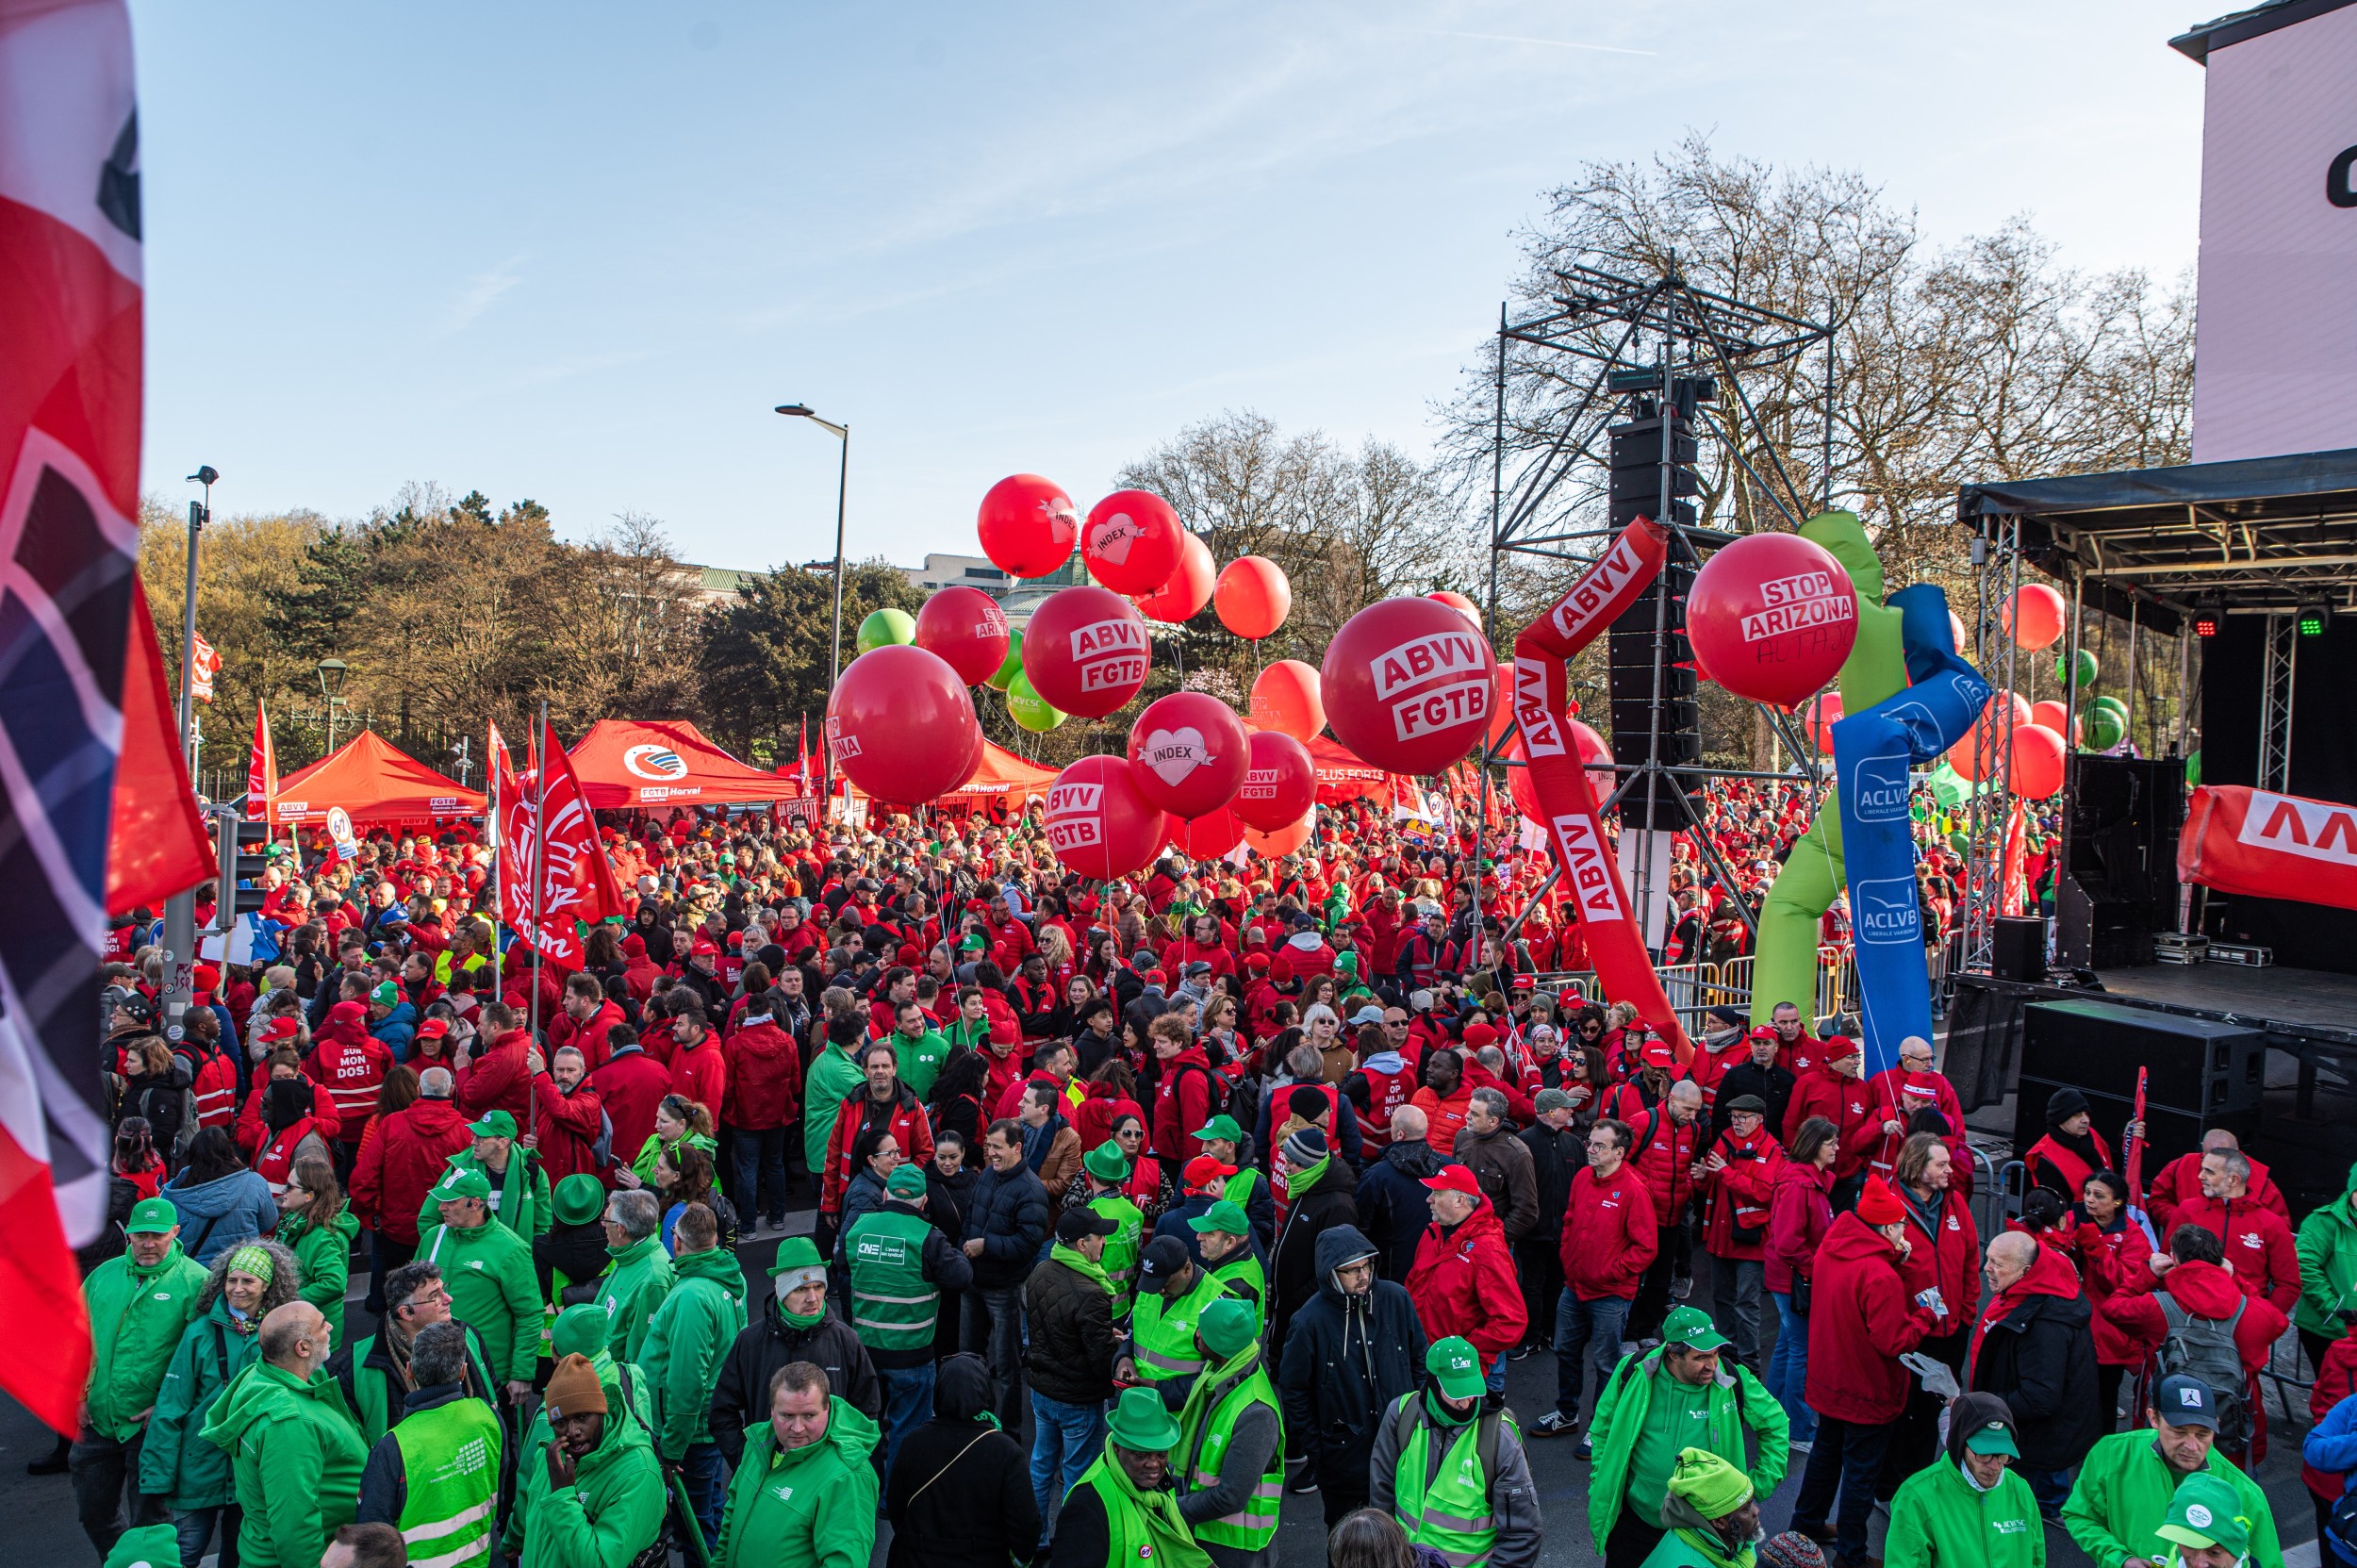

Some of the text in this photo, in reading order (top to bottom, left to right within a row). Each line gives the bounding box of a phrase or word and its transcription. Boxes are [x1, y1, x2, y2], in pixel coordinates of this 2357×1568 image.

[1055, 511, 1077, 531] INDEX
[1097, 527, 1127, 553] INDEX
[1560, 546, 1631, 632] ABVV
[1765, 573, 1829, 604] STOP
[985, 608, 1006, 621] STO
[1748, 597, 1852, 640] ARIZONA
[1079, 622, 1142, 655] ABVV
[1384, 636, 1475, 691] ABVV
[1086, 660, 1144, 688] FGTB
[1251, 697, 1267, 709] TOP
[1399, 685, 1484, 734] FGTB
[1518, 666, 1558, 747] ABVV
[1154, 746, 1193, 763] INDEX
[1316, 768, 1385, 781] PLUS FORTS
[642, 786, 701, 797] FGTB Horval
[980, 784, 1010, 793] Horval
[1243, 789, 1275, 798] FGTB
[1860, 787, 1909, 806] ACLVB
[1047, 822, 1096, 849] FGTB
[1559, 824, 1616, 912] ABVV
[1864, 909, 1917, 929] ACLVB
[340, 1055, 367, 1066] MON
[1385, 1094, 1405, 1104] MIJN
[1390, 1085, 1401, 1094] OP
[858, 1243, 880, 1256] CNE
